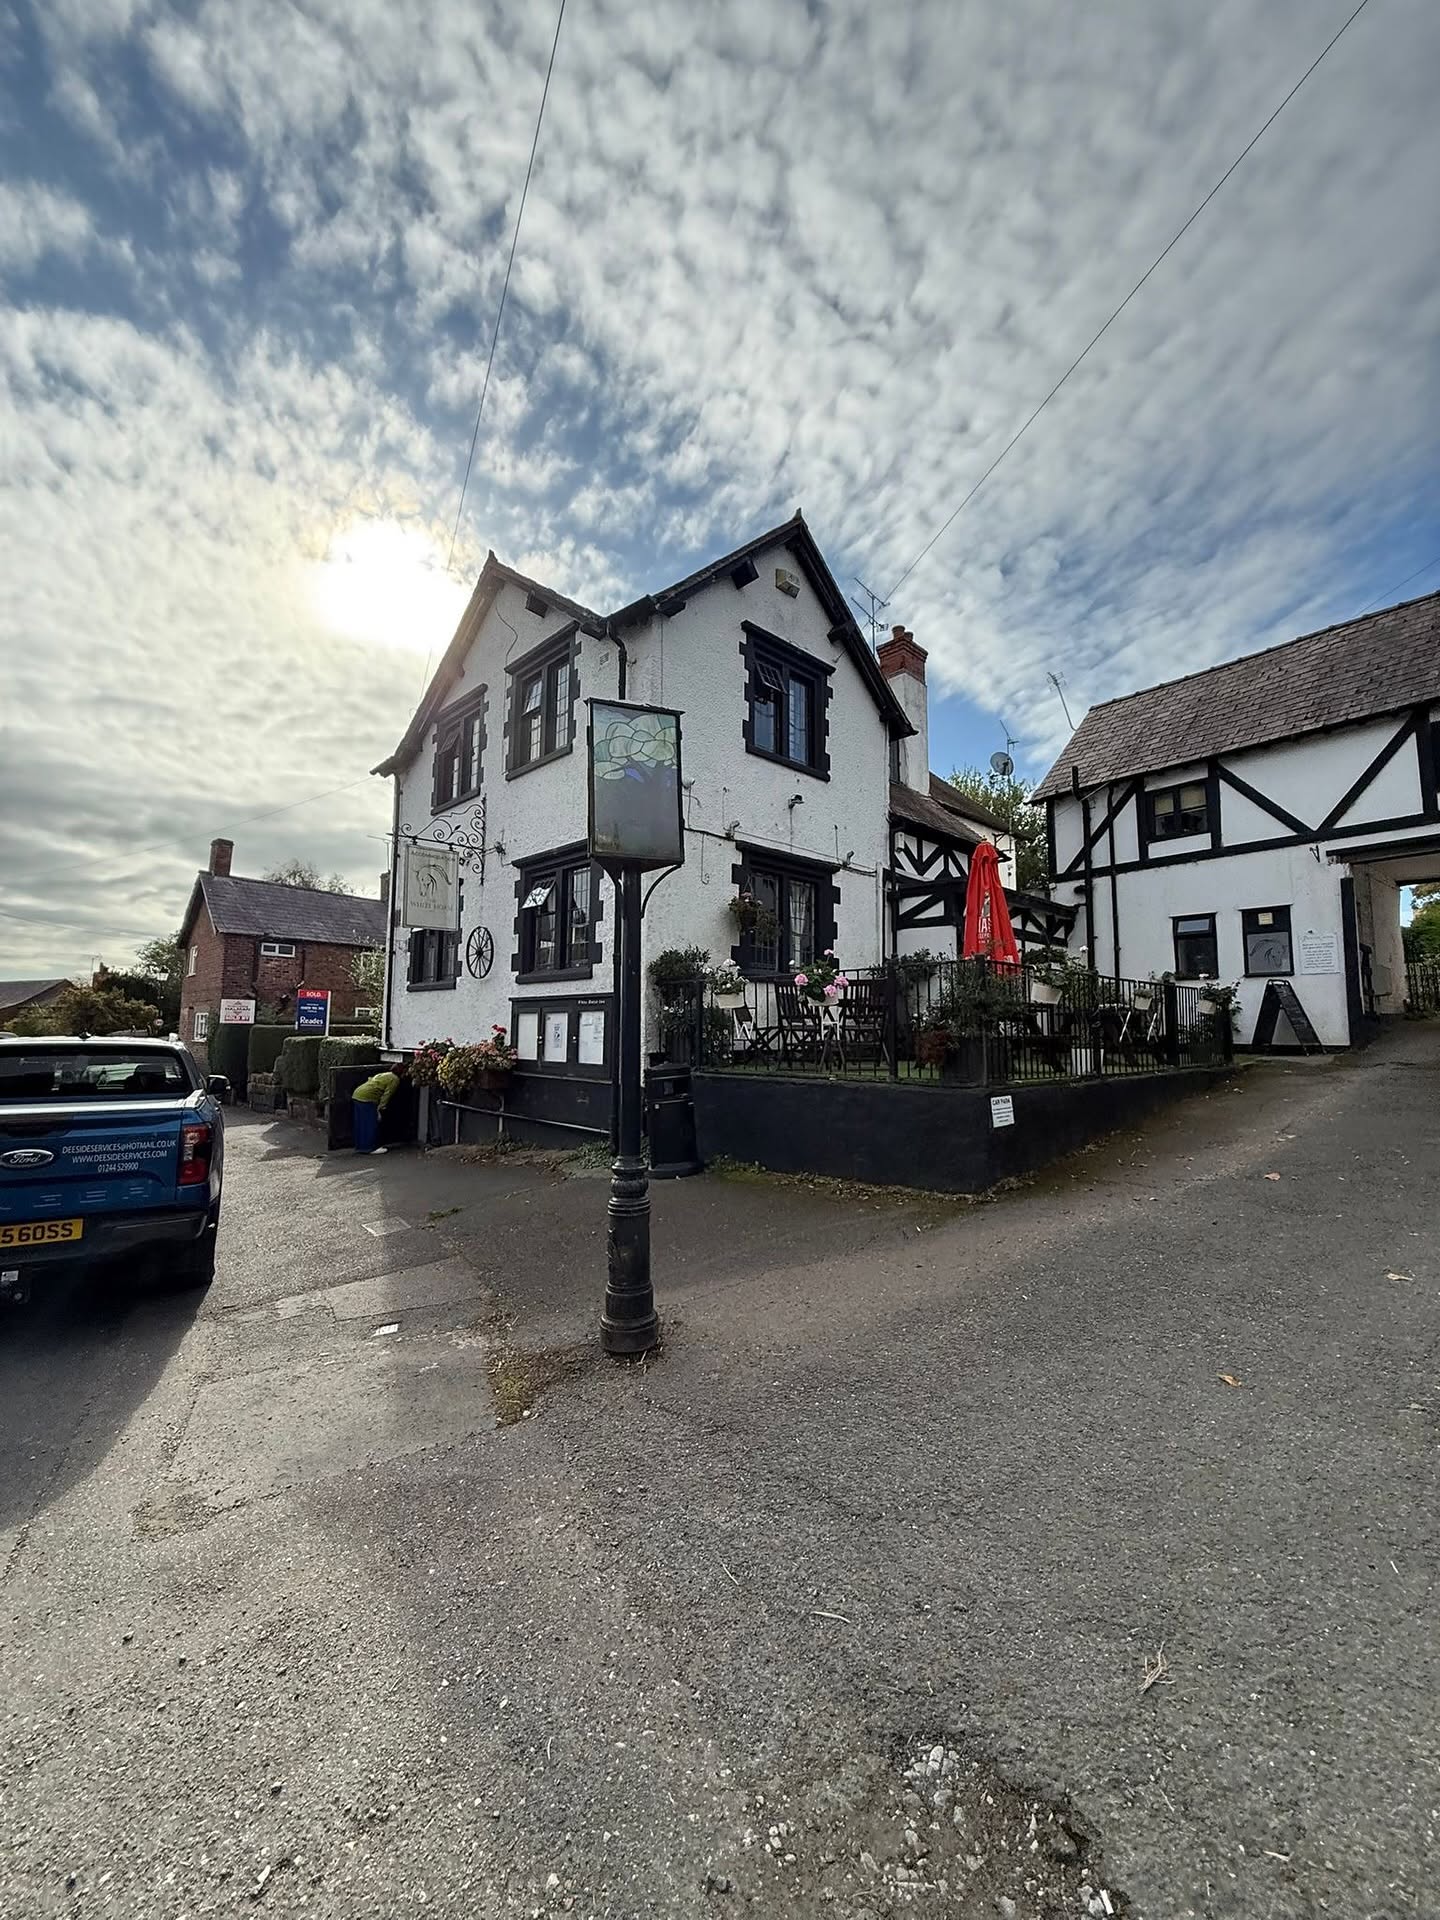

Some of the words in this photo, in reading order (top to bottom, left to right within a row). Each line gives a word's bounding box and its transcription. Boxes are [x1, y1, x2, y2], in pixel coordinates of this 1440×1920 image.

[300, 1016, 323, 1025] Reades
[62, 1140, 177, 1154] DEESIDESERVICES@HOTMAIL.CO.UK
[10, 1152, 40, 1164] Ford
[72, 1150, 168, 1163] WWW.DEESIDESERVICES.COM
[97, 1164, 116, 1173] 01244
